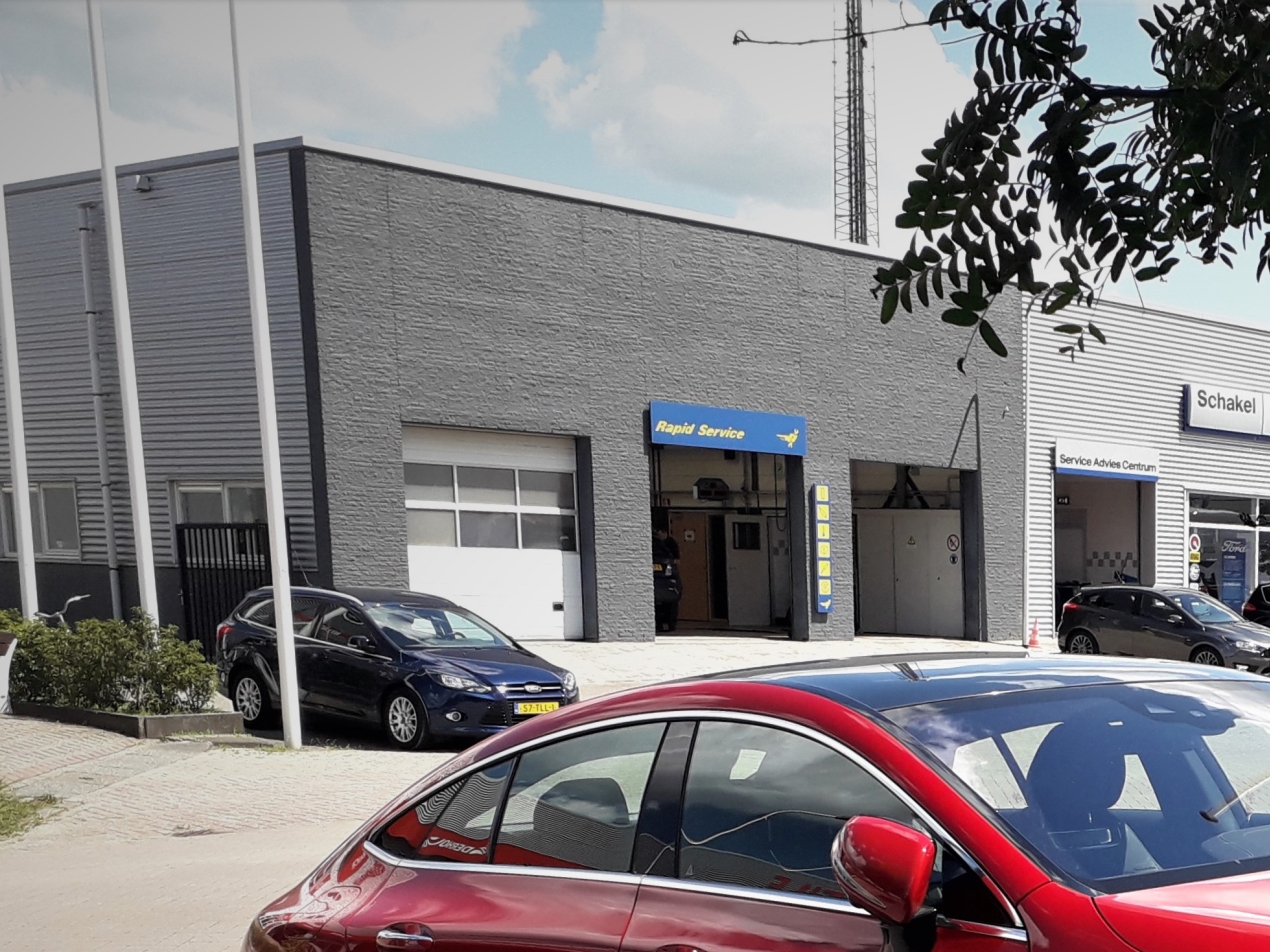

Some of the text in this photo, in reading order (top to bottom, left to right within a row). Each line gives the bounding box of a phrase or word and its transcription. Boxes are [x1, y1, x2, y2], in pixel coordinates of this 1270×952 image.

[1197, 389, 1256, 414] Schakel
[654, 420, 746, 440] Rapid Service
[1059, 454, 1157, 472] Service Advies Centrum
[1221, 540, 1248, 553] Ford
